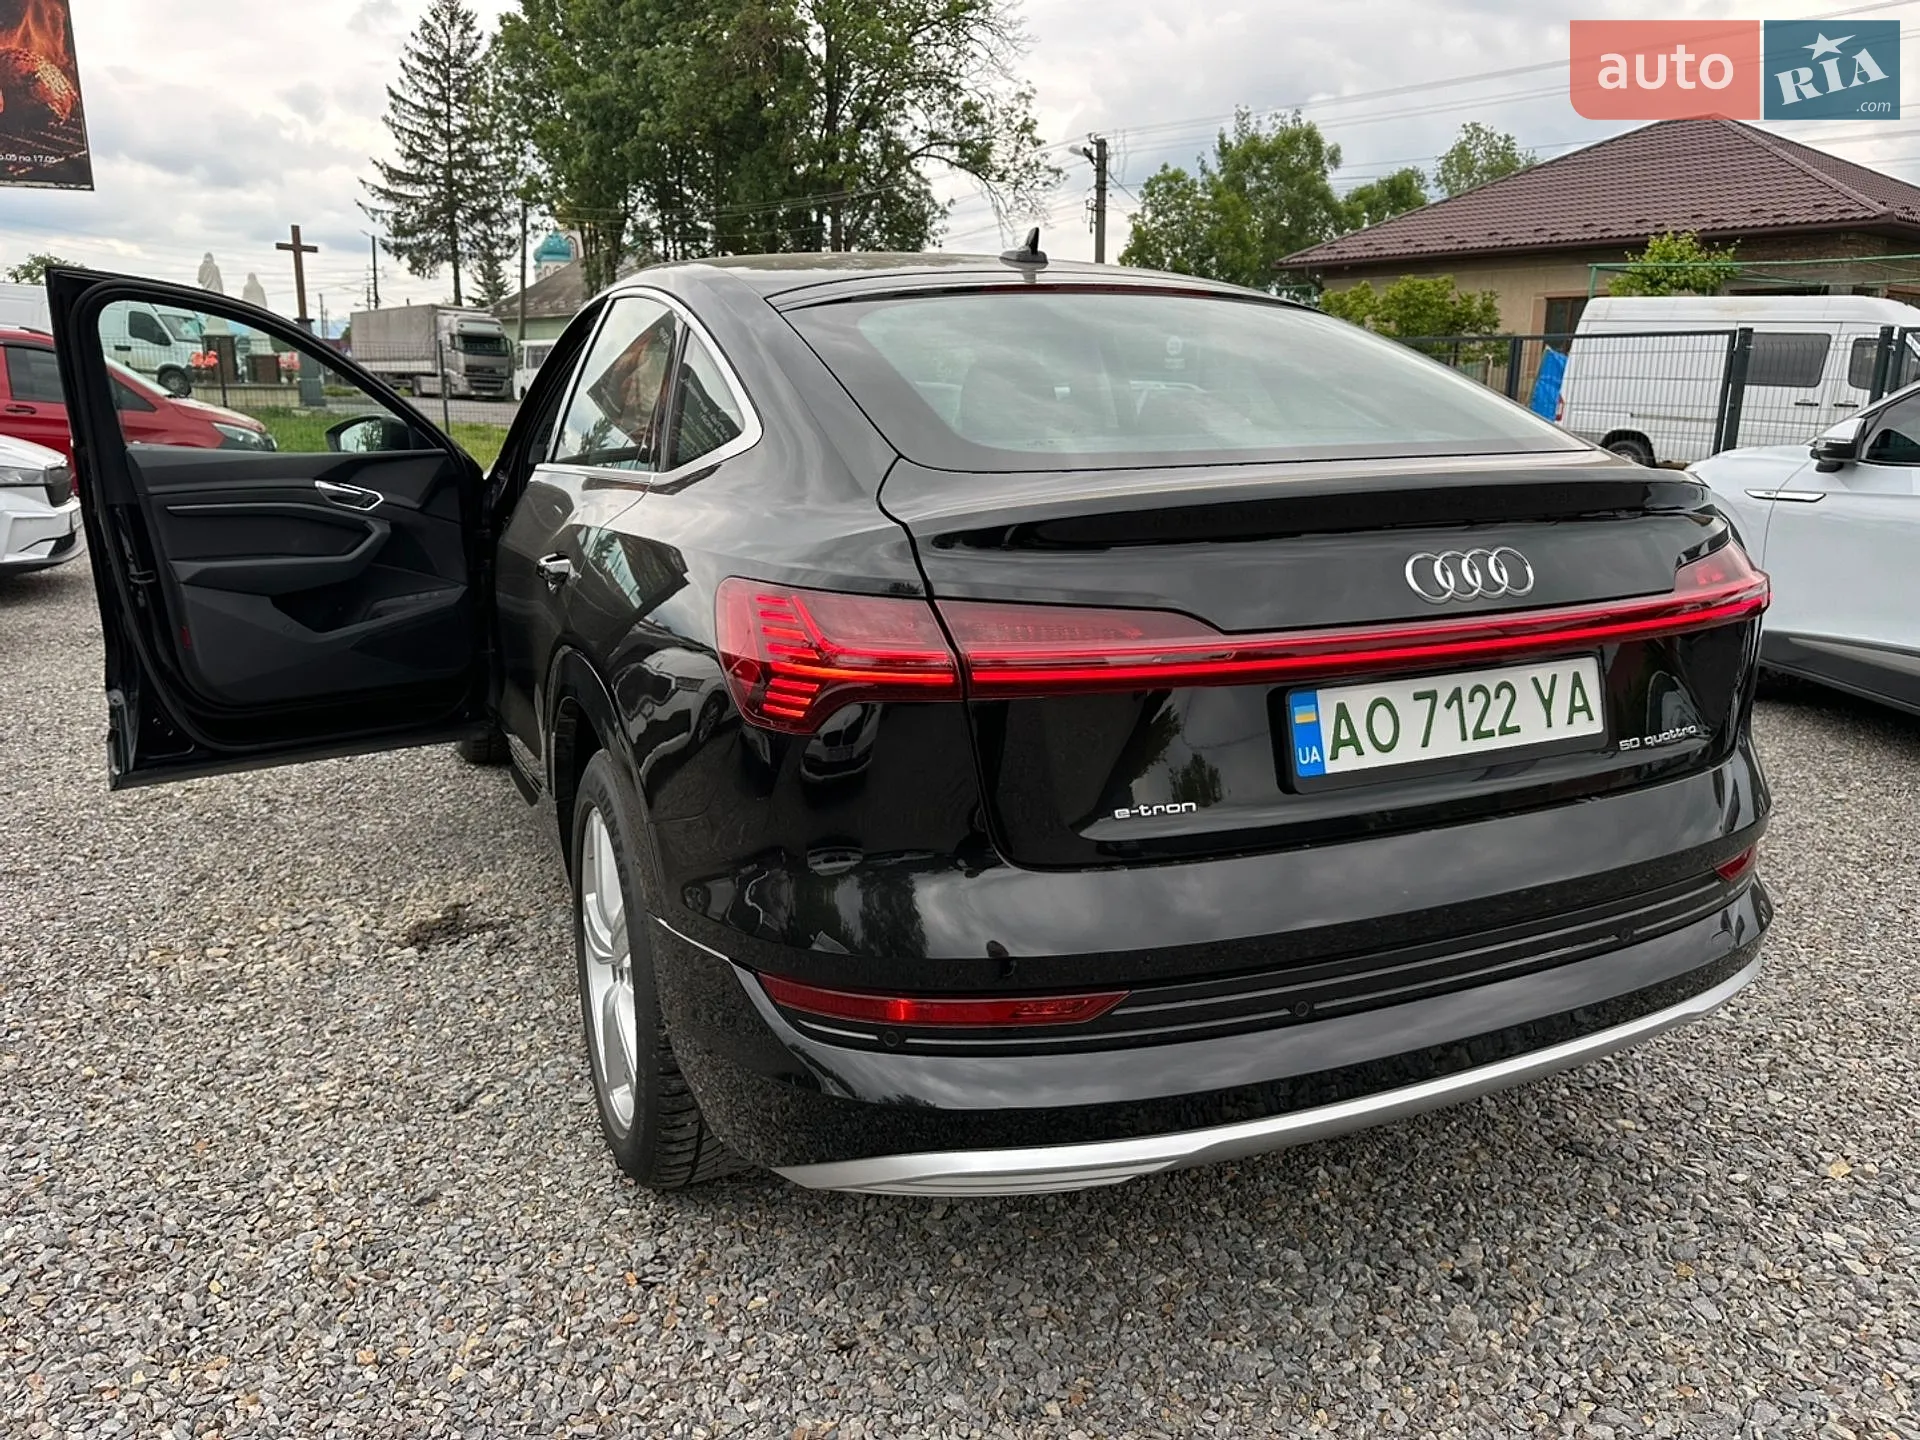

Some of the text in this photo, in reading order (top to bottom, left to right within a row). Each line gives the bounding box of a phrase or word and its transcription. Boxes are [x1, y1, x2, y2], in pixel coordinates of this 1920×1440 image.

[1329, 671, 1595, 761] AO 7122 YA
[1619, 725, 1697, 751] 50 quattro
[1298, 745, 1322, 765] UA
[1114, 802, 1197, 819] e-tron
